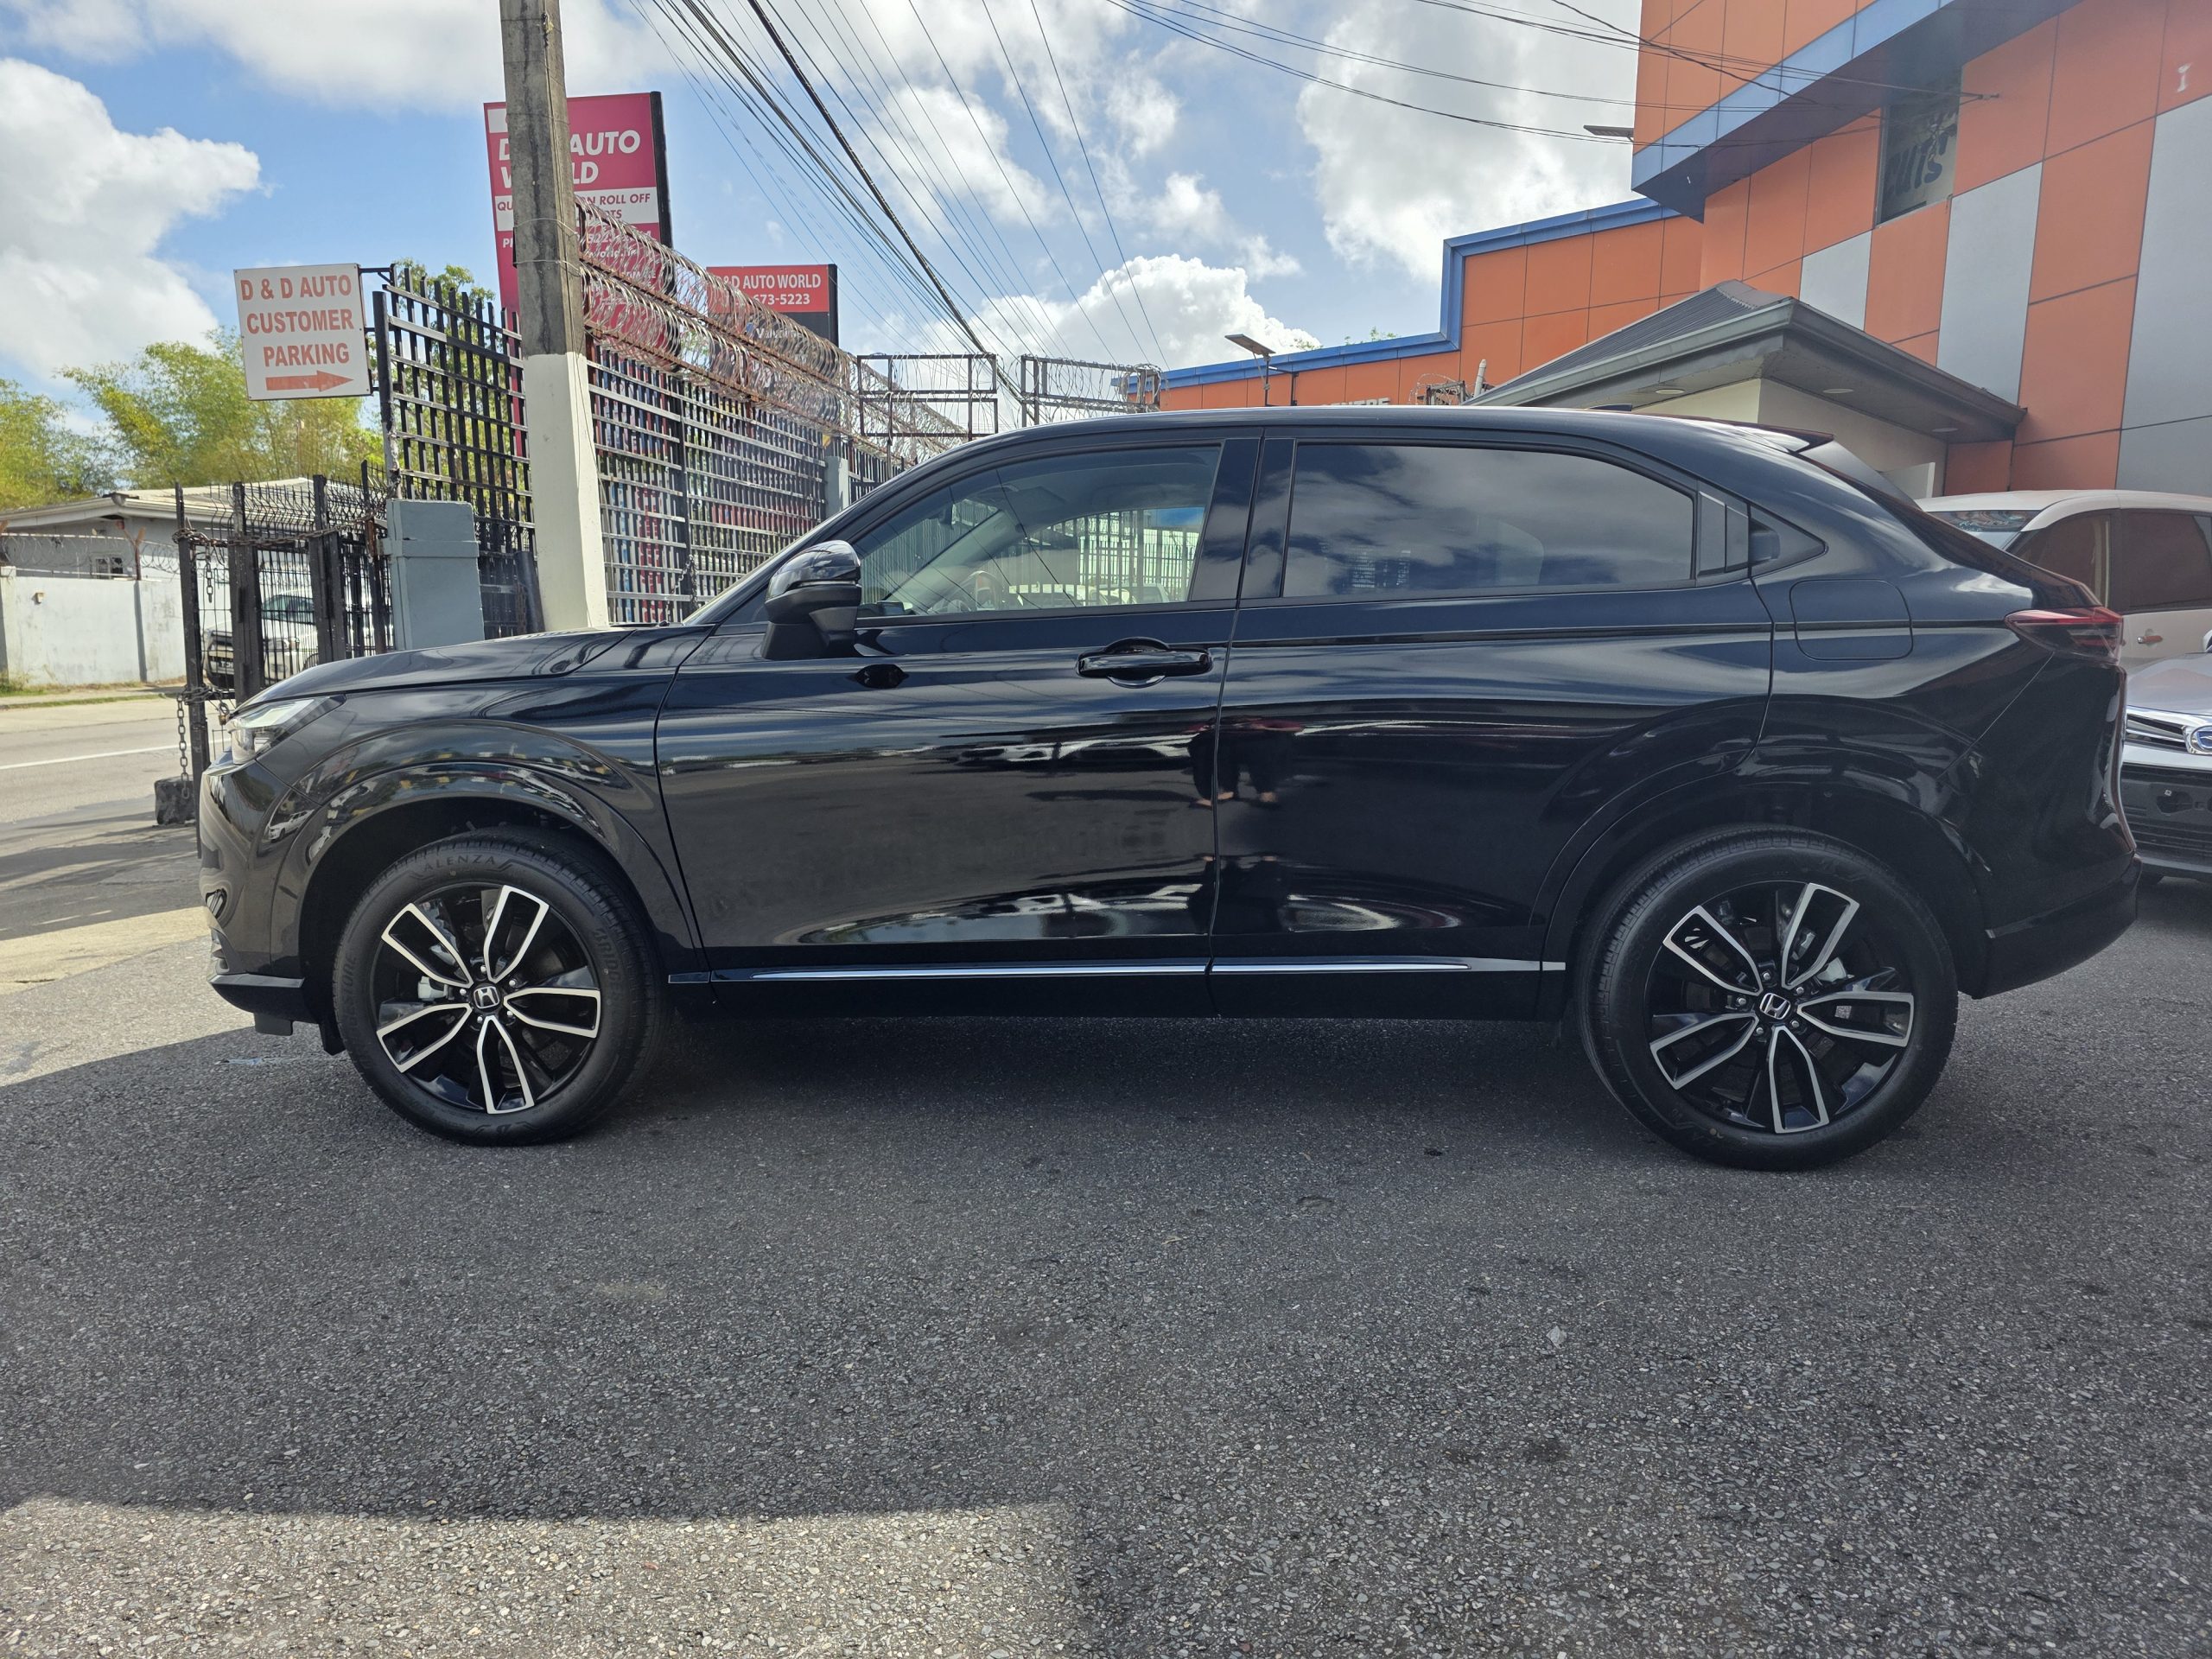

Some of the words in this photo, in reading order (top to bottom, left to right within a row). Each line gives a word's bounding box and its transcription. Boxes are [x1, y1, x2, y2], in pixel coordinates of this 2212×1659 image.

[570, 130, 640, 156] AUTO
[600, 195, 626, 205] ROLL
[630, 193, 651, 204] OFF
[240, 279, 253, 301] D
[261, 277, 274, 299] &
[280, 277, 293, 299] D
[300, 275, 352, 298] AUTO
[719, 276, 741, 289] &D
[743, 275, 775, 289] AUTO
[778, 274, 821, 289] WORLD
[246, 308, 354, 334] CUSTOMER
[263, 342, 350, 367] PARKING
[424, 854, 496, 872] ALENZA
